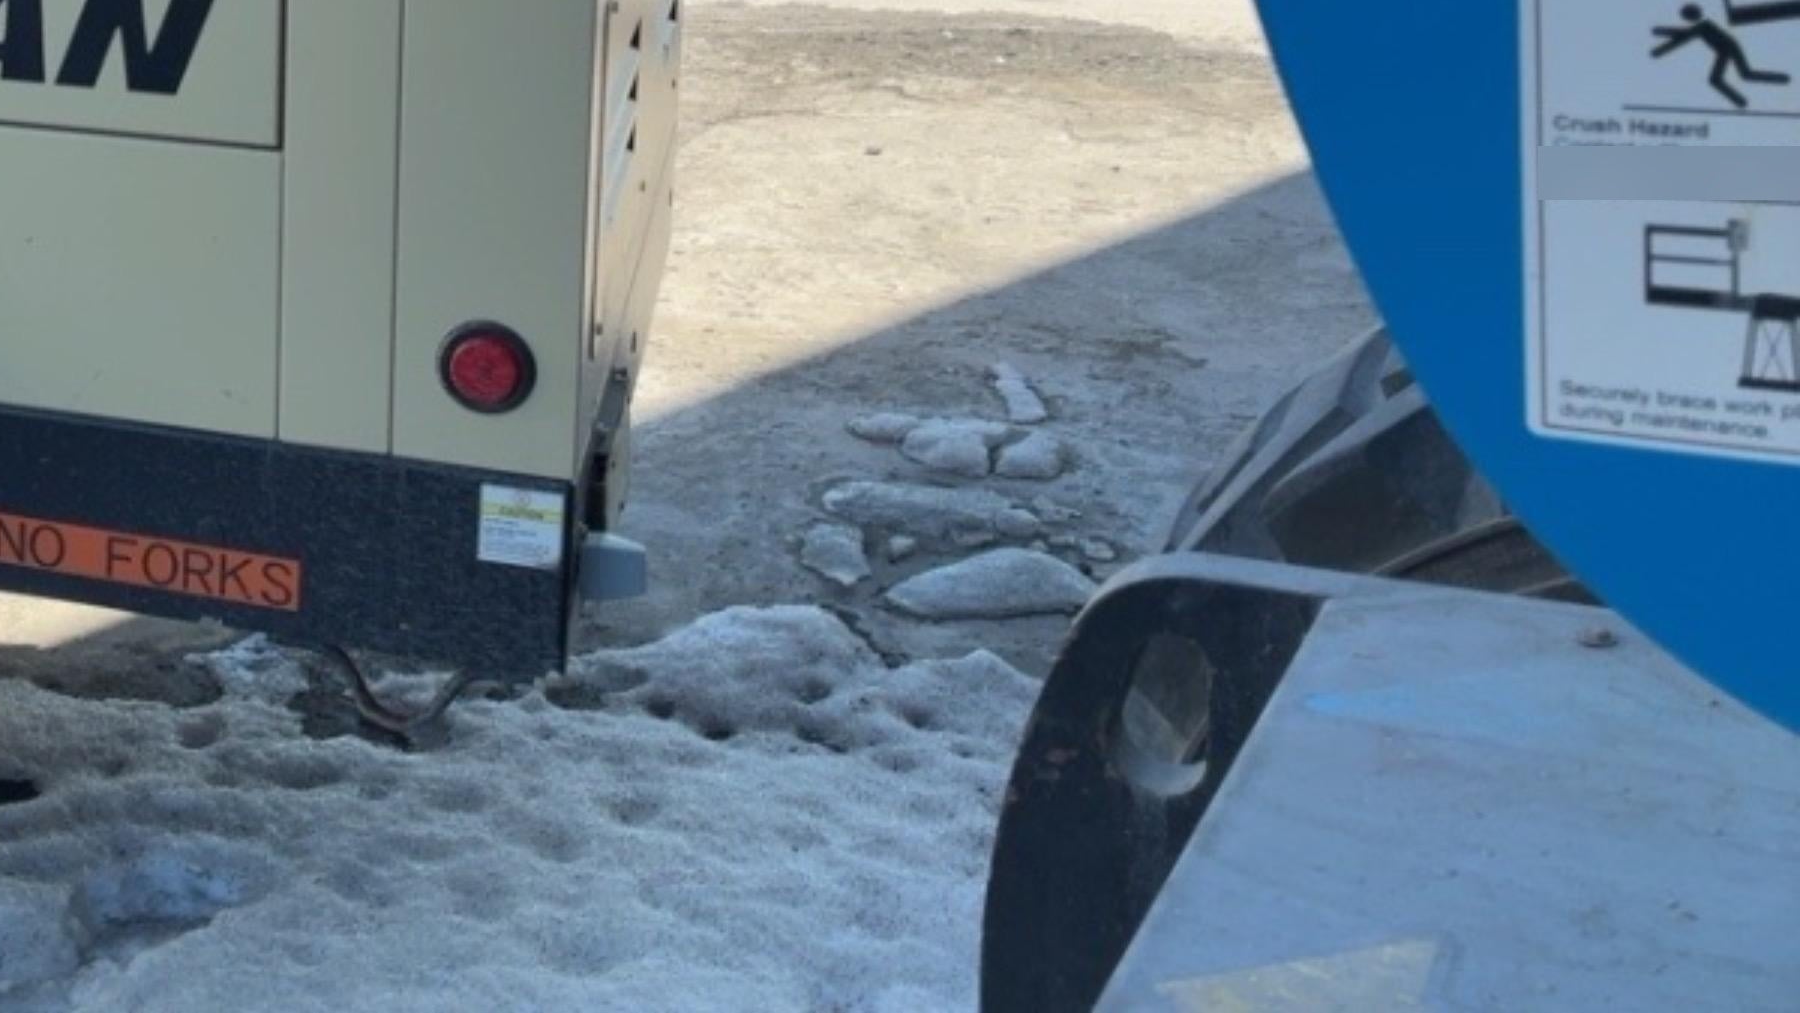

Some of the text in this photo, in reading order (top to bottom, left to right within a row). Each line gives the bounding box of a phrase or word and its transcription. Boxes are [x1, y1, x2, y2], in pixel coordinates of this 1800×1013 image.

[1552, 114, 1711, 140] Crush Hazard
[1559, 379, 1649, 407] Securely
[1559, 402, 1624, 427] during
[105, 536, 294, 607] FORKS
